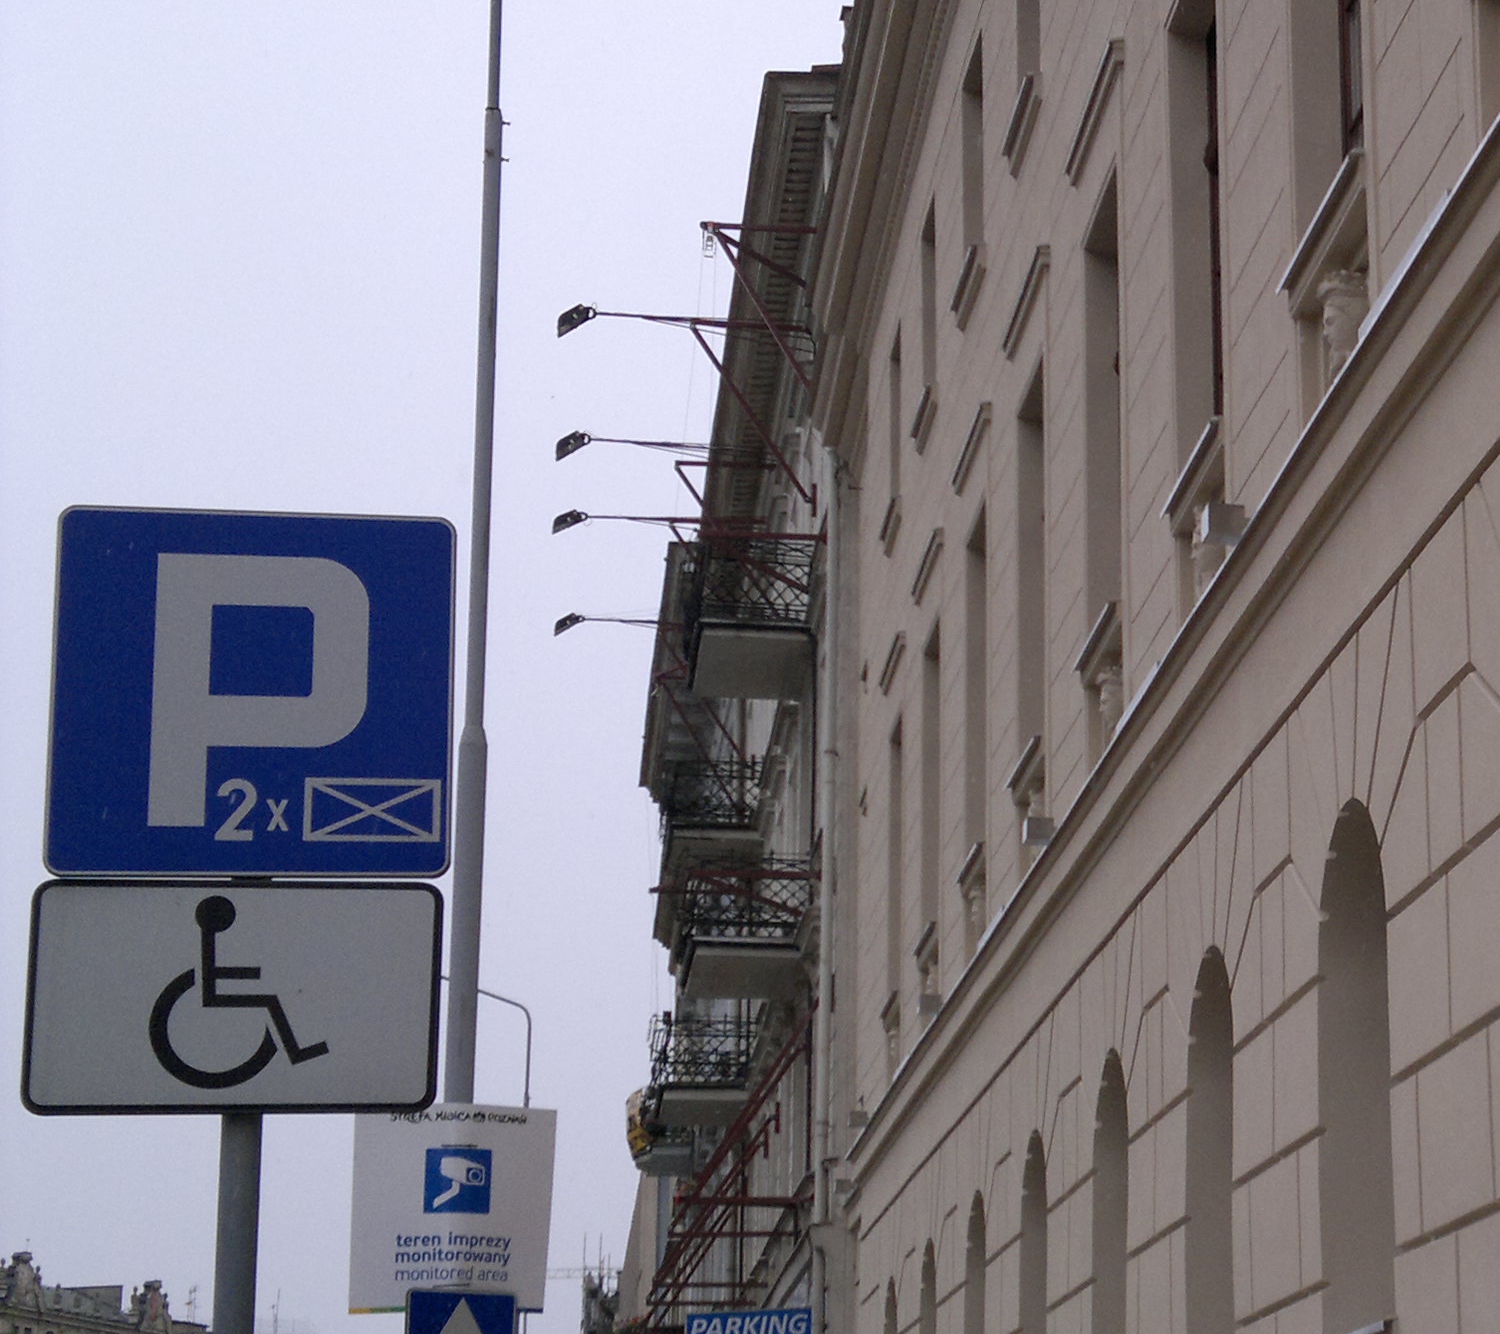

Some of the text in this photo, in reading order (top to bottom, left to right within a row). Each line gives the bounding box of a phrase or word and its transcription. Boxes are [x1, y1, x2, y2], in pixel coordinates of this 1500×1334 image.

[147, 552, 370, 828] P
[396, 1231, 511, 1250] teren imprezy
[395, 1248, 511, 1267] monitorowany
[394, 1266, 508, 1282] monitored area
